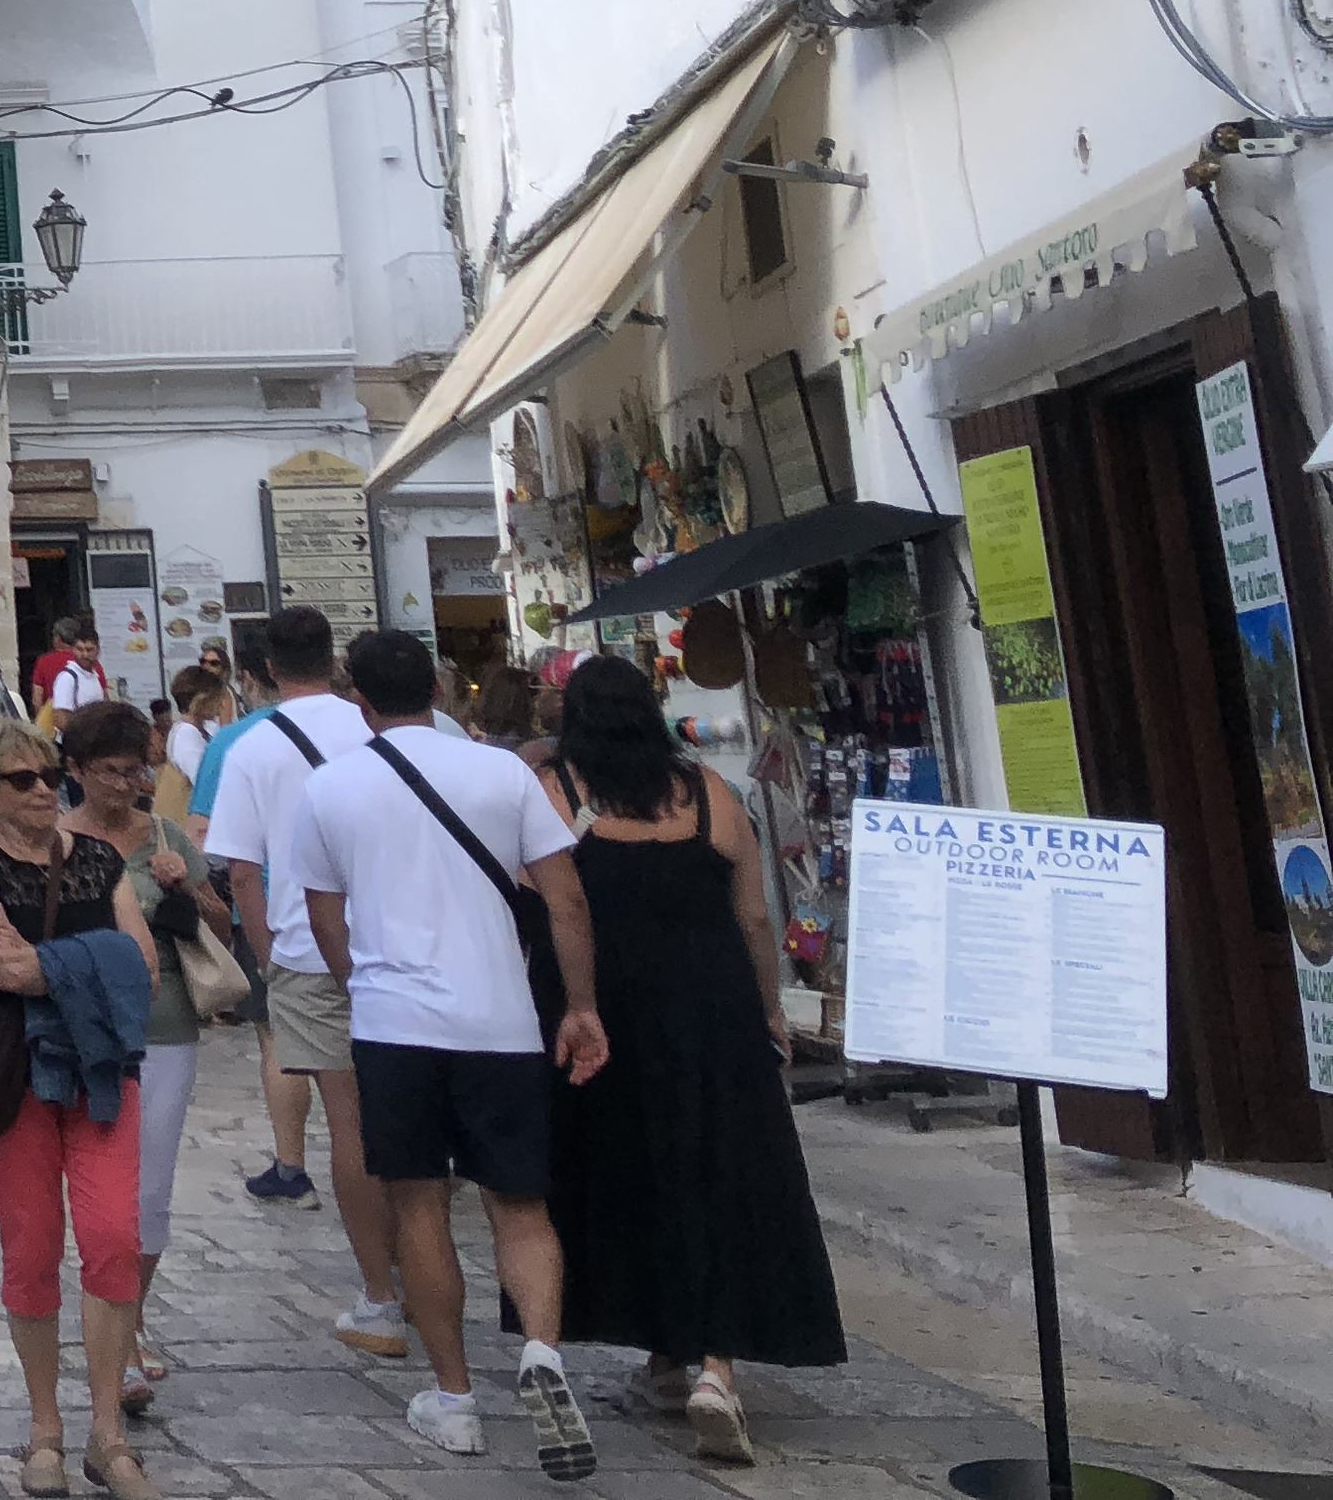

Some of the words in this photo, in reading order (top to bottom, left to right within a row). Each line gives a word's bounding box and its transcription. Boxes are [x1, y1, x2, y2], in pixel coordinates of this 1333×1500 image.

[864, 810, 959, 840] SALA
[977, 820, 1152, 858] ESTERNA
[894, 837, 1024, 863] OUTDOOR
[1037, 850, 1120, 873] ROOM
[946, 859, 1038, 881] PIZZERIA
